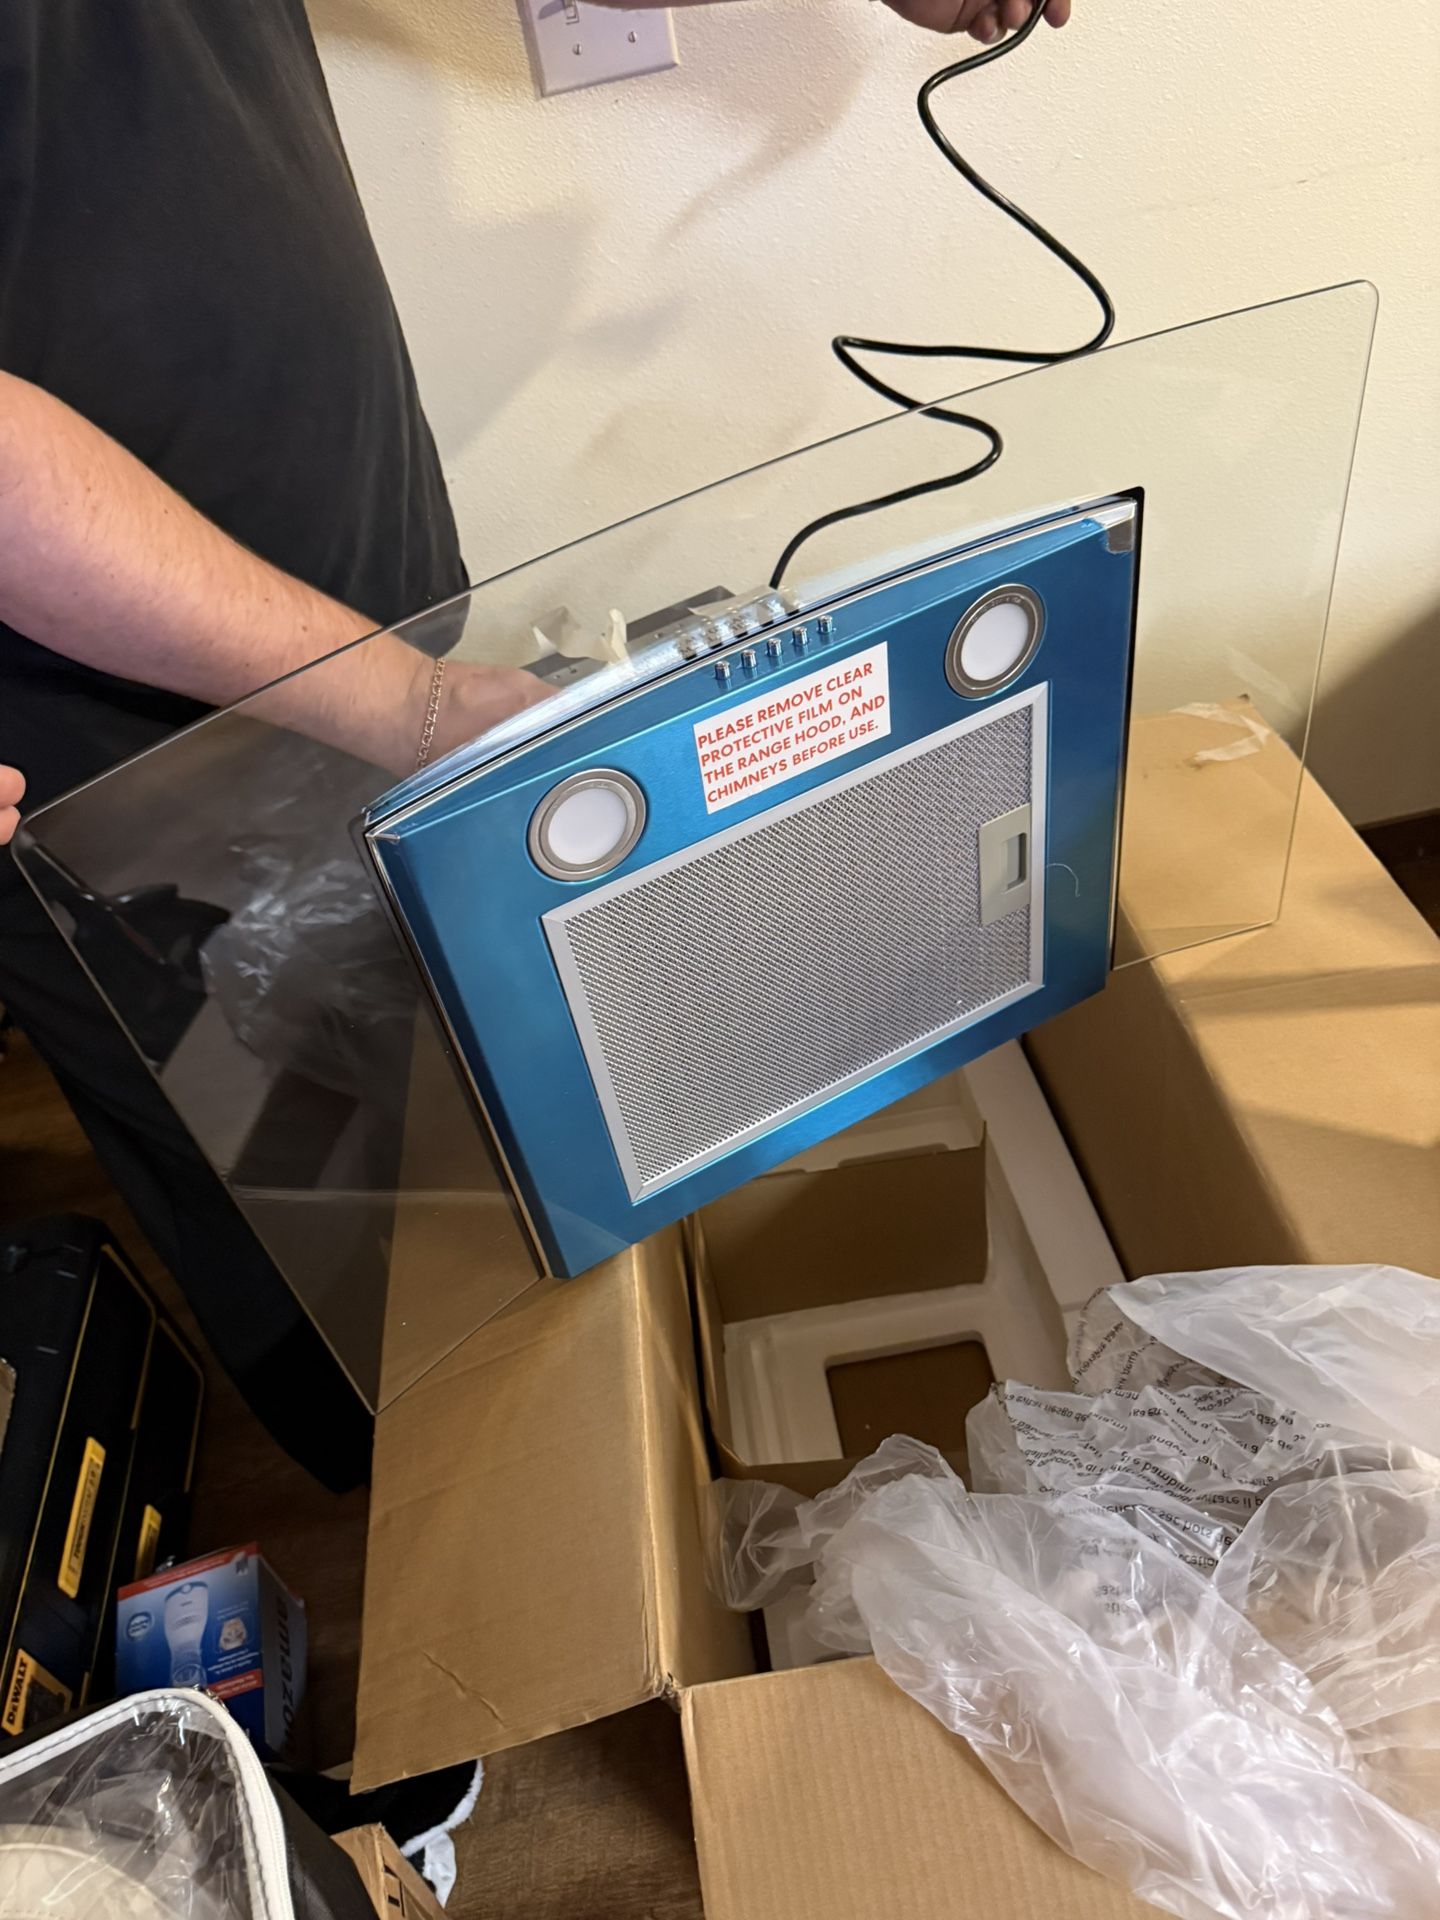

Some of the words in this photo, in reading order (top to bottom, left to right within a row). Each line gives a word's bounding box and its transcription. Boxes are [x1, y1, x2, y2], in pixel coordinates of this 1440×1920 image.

[698, 715, 754, 749] PLEASE
[757, 684, 823, 723] REMOVE
[826, 662, 873, 692] CLEAR
[701, 717, 793, 767] PROTECTIVE
[798, 699, 833, 725] FILM
[838, 685, 863, 706] ON
[704, 762, 734, 785] THE
[737, 737, 791, 771] RANGE
[794, 715, 846, 745] HOOD,
[850, 695, 885, 720] AND
[707, 759, 788, 803] CHIMNEYS
[792, 732, 846, 766] BEFORE
[849, 719, 879, 740] USE.
